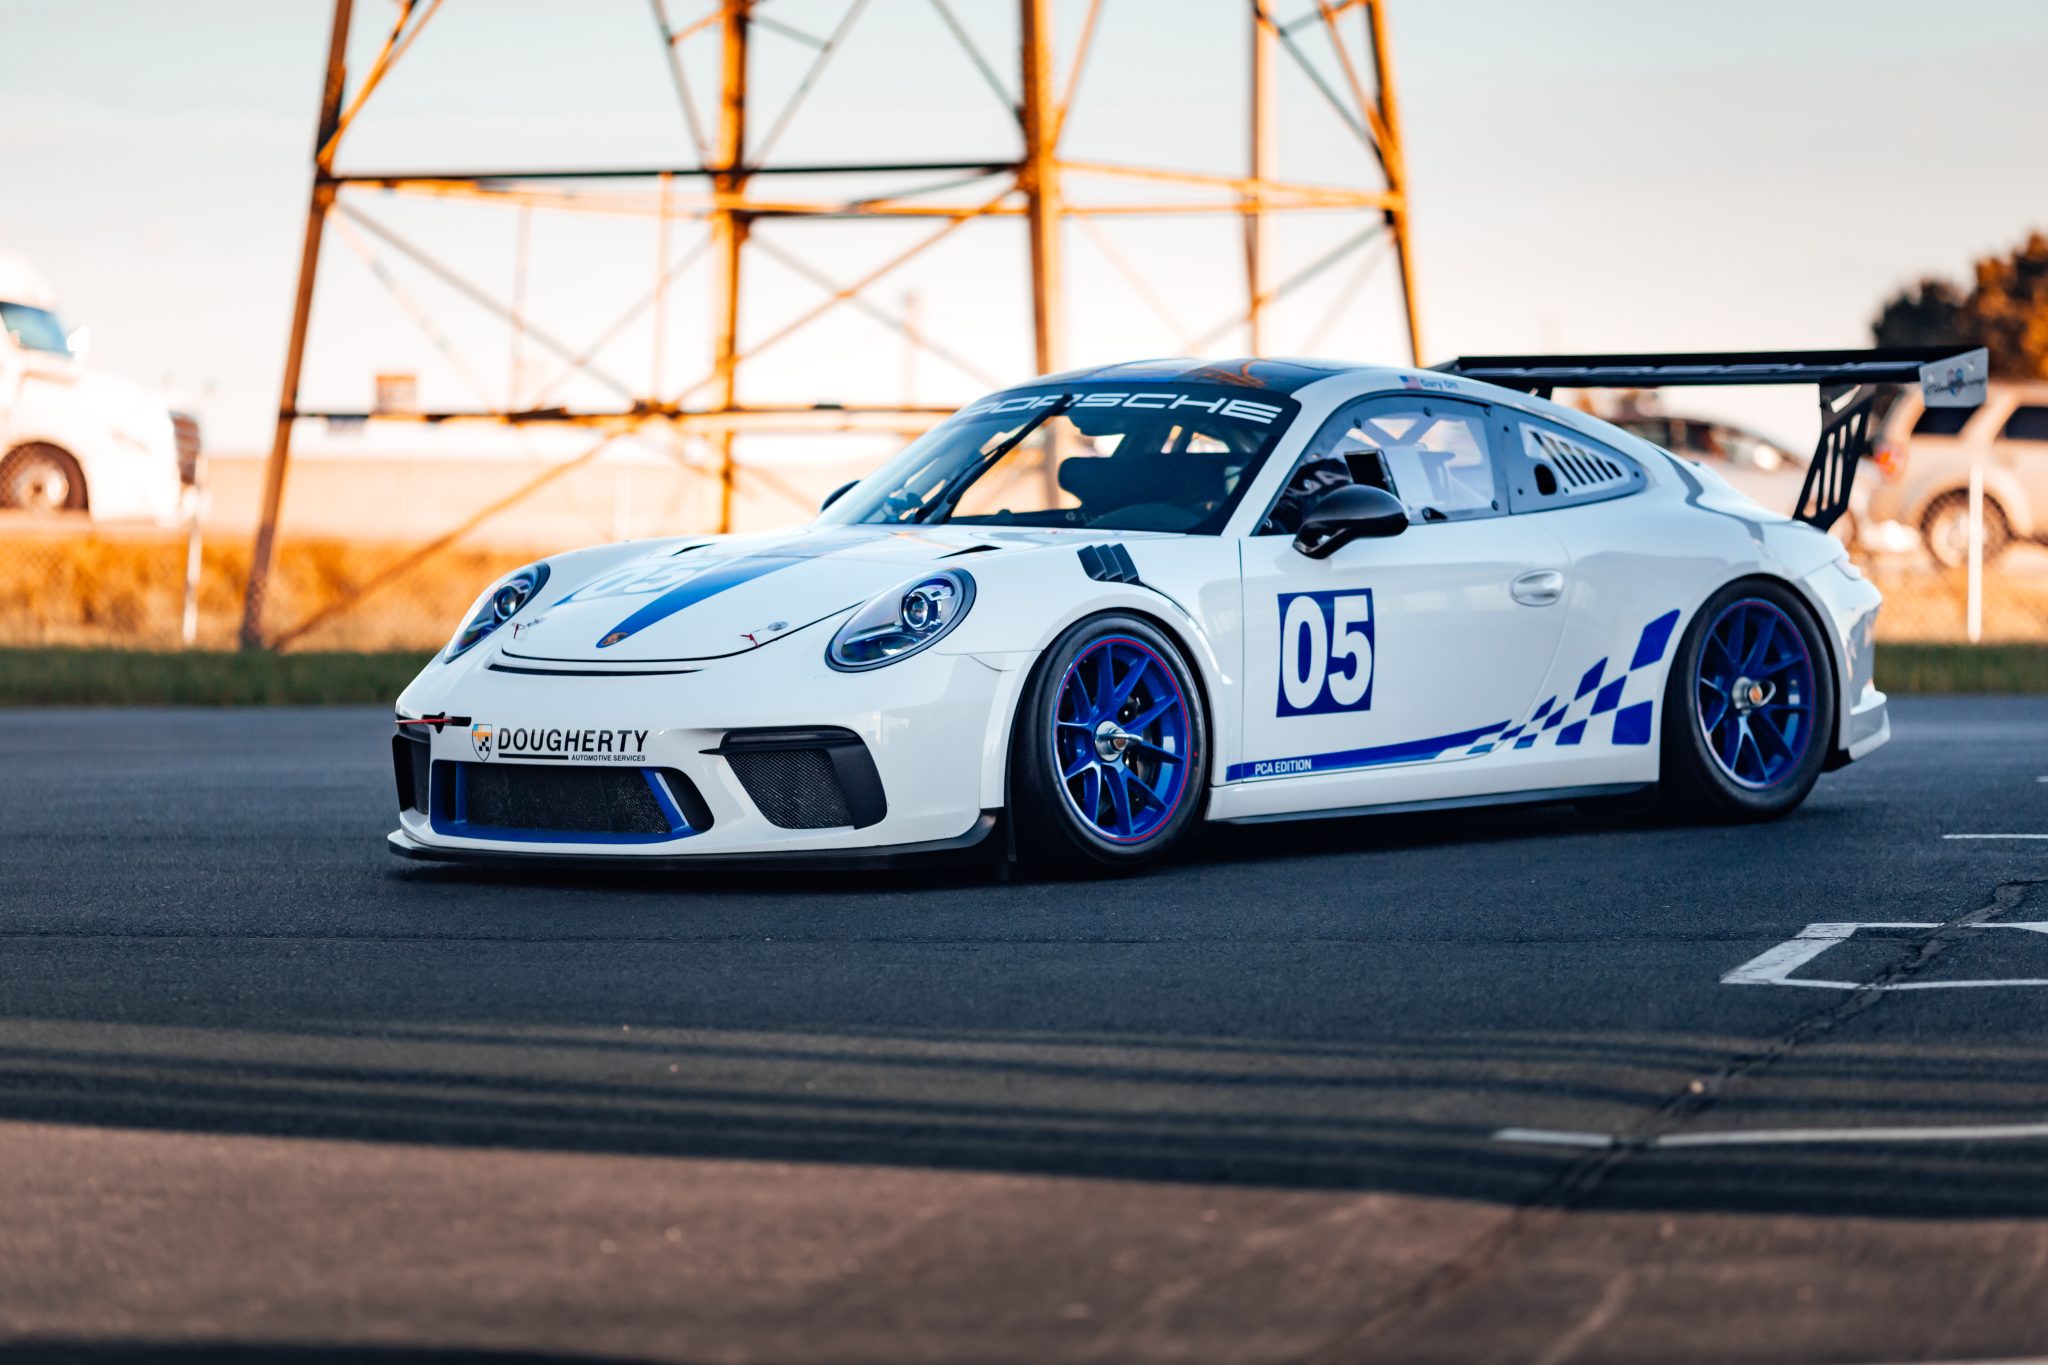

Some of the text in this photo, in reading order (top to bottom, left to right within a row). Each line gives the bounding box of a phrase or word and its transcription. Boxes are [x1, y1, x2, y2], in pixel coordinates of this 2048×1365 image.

[1282, 594, 1372, 709] 05
[498, 728, 649, 752] DOUGHERTY
[1255, 759, 1311, 775] PCA EDITION
